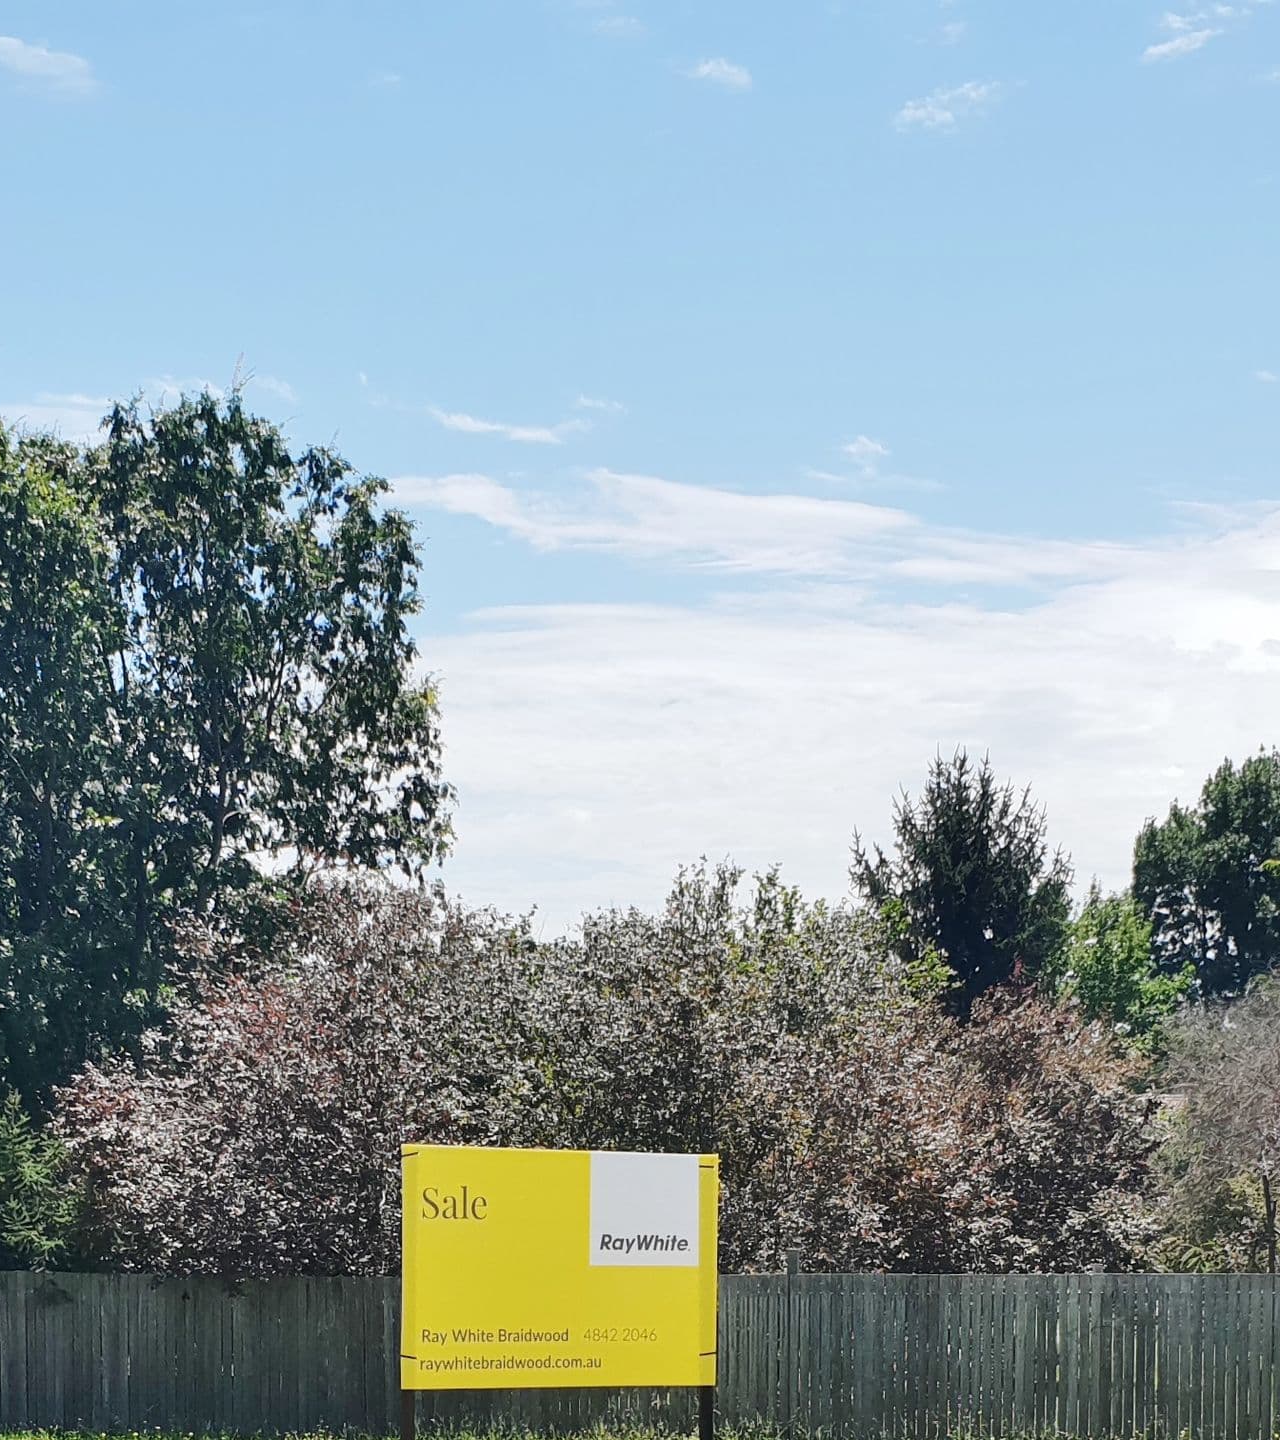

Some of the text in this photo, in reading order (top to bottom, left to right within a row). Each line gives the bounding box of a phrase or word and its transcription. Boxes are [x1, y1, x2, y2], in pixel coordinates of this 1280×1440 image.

[421, 1186, 488, 1221] Sale
[599, 1234, 689, 1254] RayWhite
[421, 1328, 658, 1345] Ray White Braidwood 4842 2046
[419, 1355, 602, 1372] raywhitebraidwood.com.au
